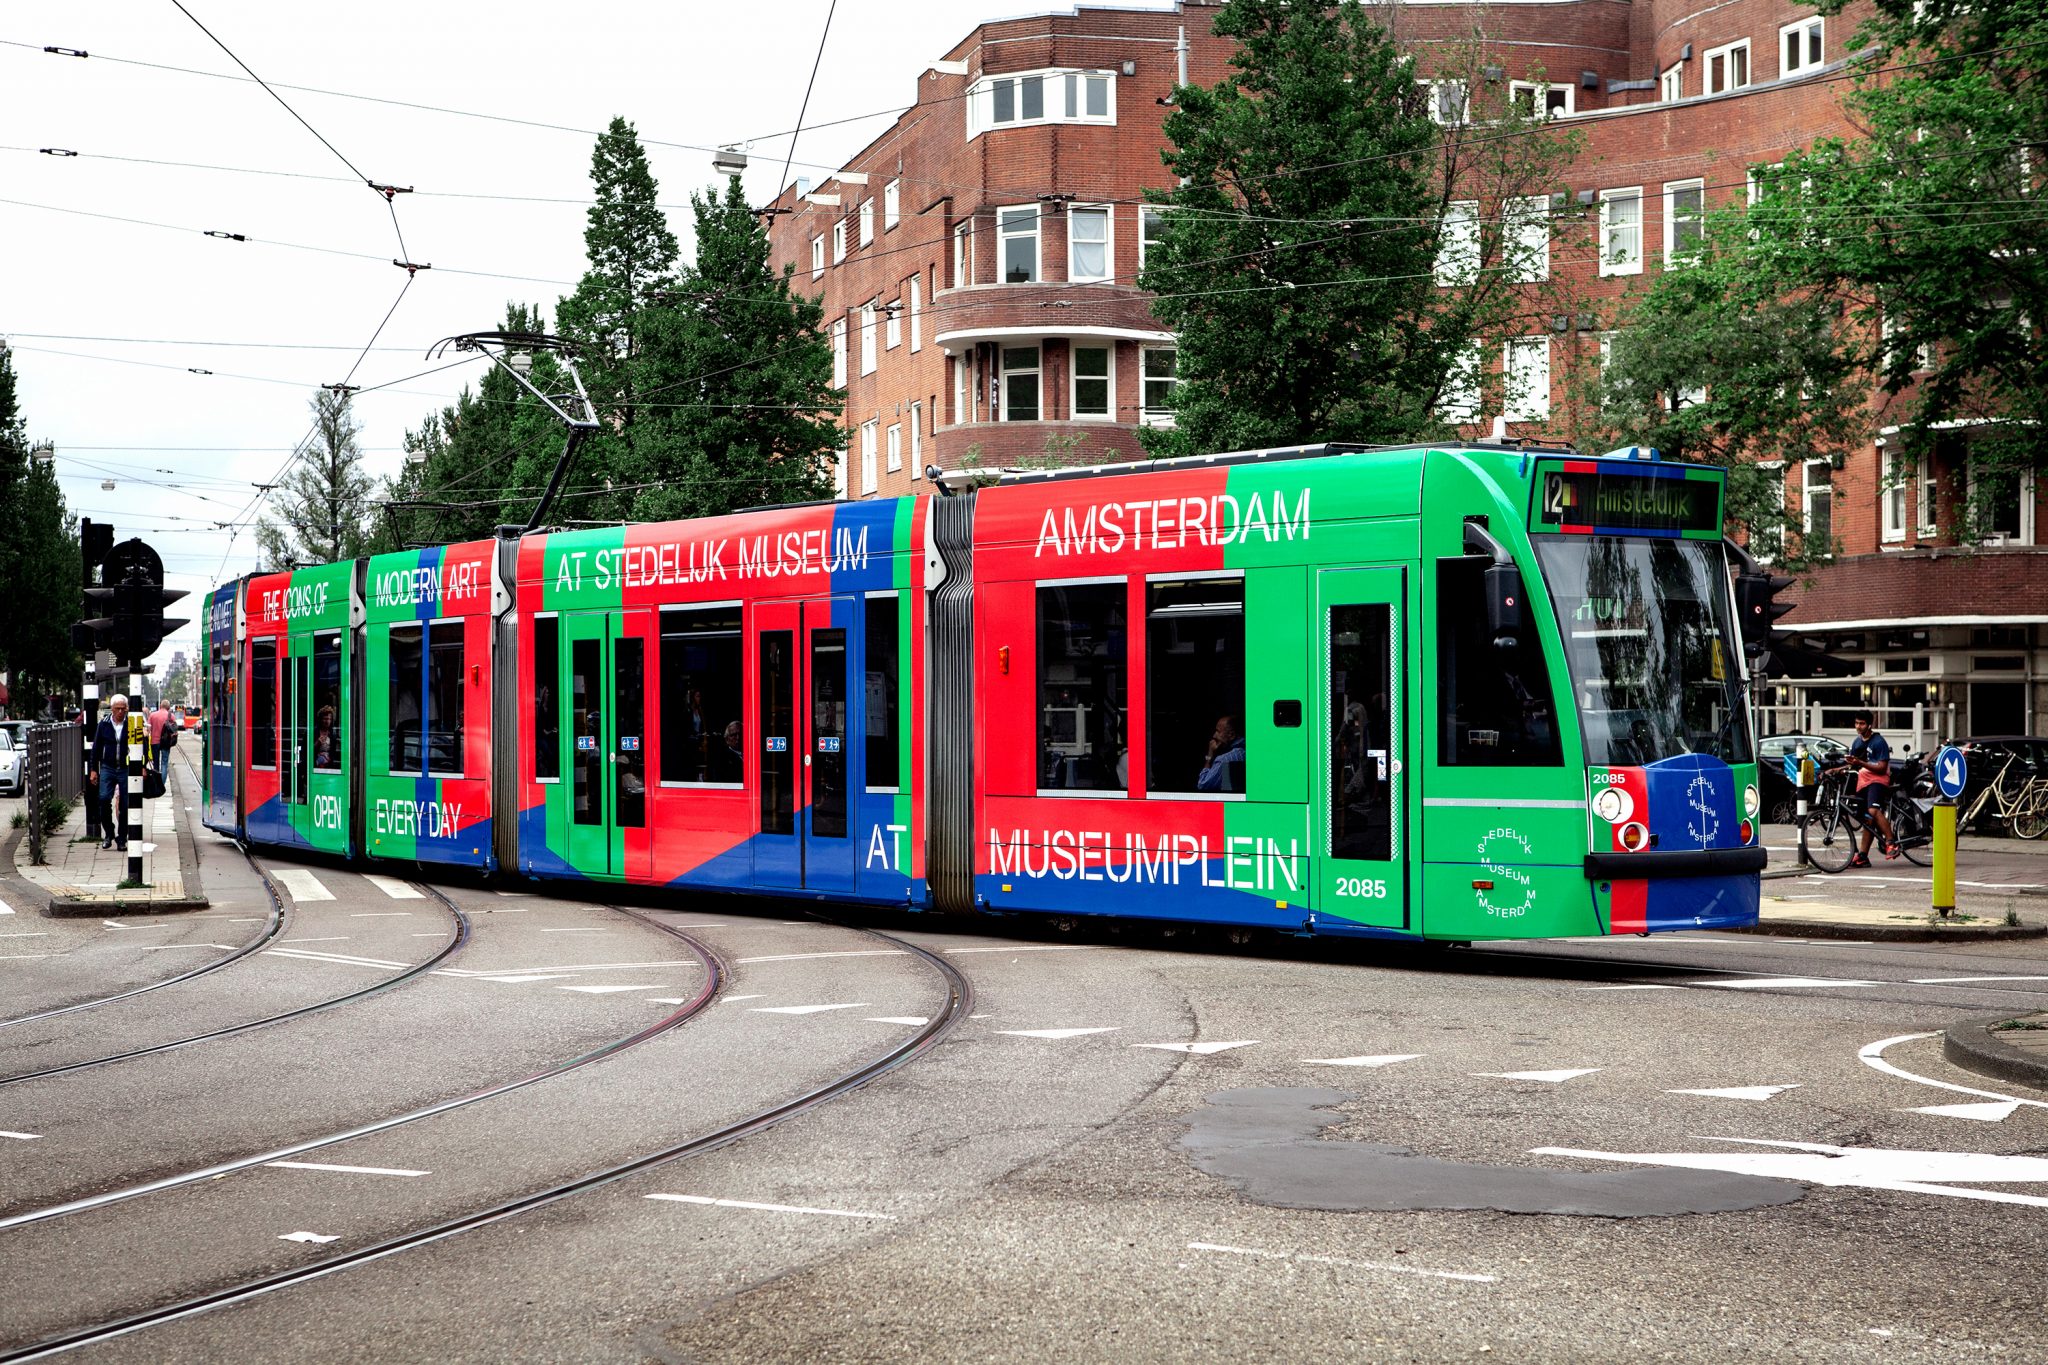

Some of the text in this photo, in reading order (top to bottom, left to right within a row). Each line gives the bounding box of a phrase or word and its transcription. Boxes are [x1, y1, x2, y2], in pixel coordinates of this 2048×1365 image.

[1544, 475, 1563, 513] 12
[1035, 488, 1311, 558] AMSTERDAM
[555, 525, 869, 592] AT STEDELIJK MUSEUM
[376, 561, 481, 607] MODERN ART
[263, 582, 329, 622] THE ICONS OF
[1593, 774, 1625, 784] 2085
[1687, 777, 1715, 797] STEDELIJK
[314, 795, 341, 830] OPEN
[376, 799, 461, 839] EVERY DAY
[1690, 799, 1716, 818] MUSEUM
[866, 823, 907, 870] AT
[1477, 828, 1532, 854] STEDELIJK
[1688, 820, 1719, 843] AMSTERDAM
[989, 827, 1298, 891] MUSEUMPLEIN
[1481, 857, 1530, 885] MUSEUM
[1335, 877, 1387, 899] 2085
[1476, 888, 1536, 918] AMSTERDAM
